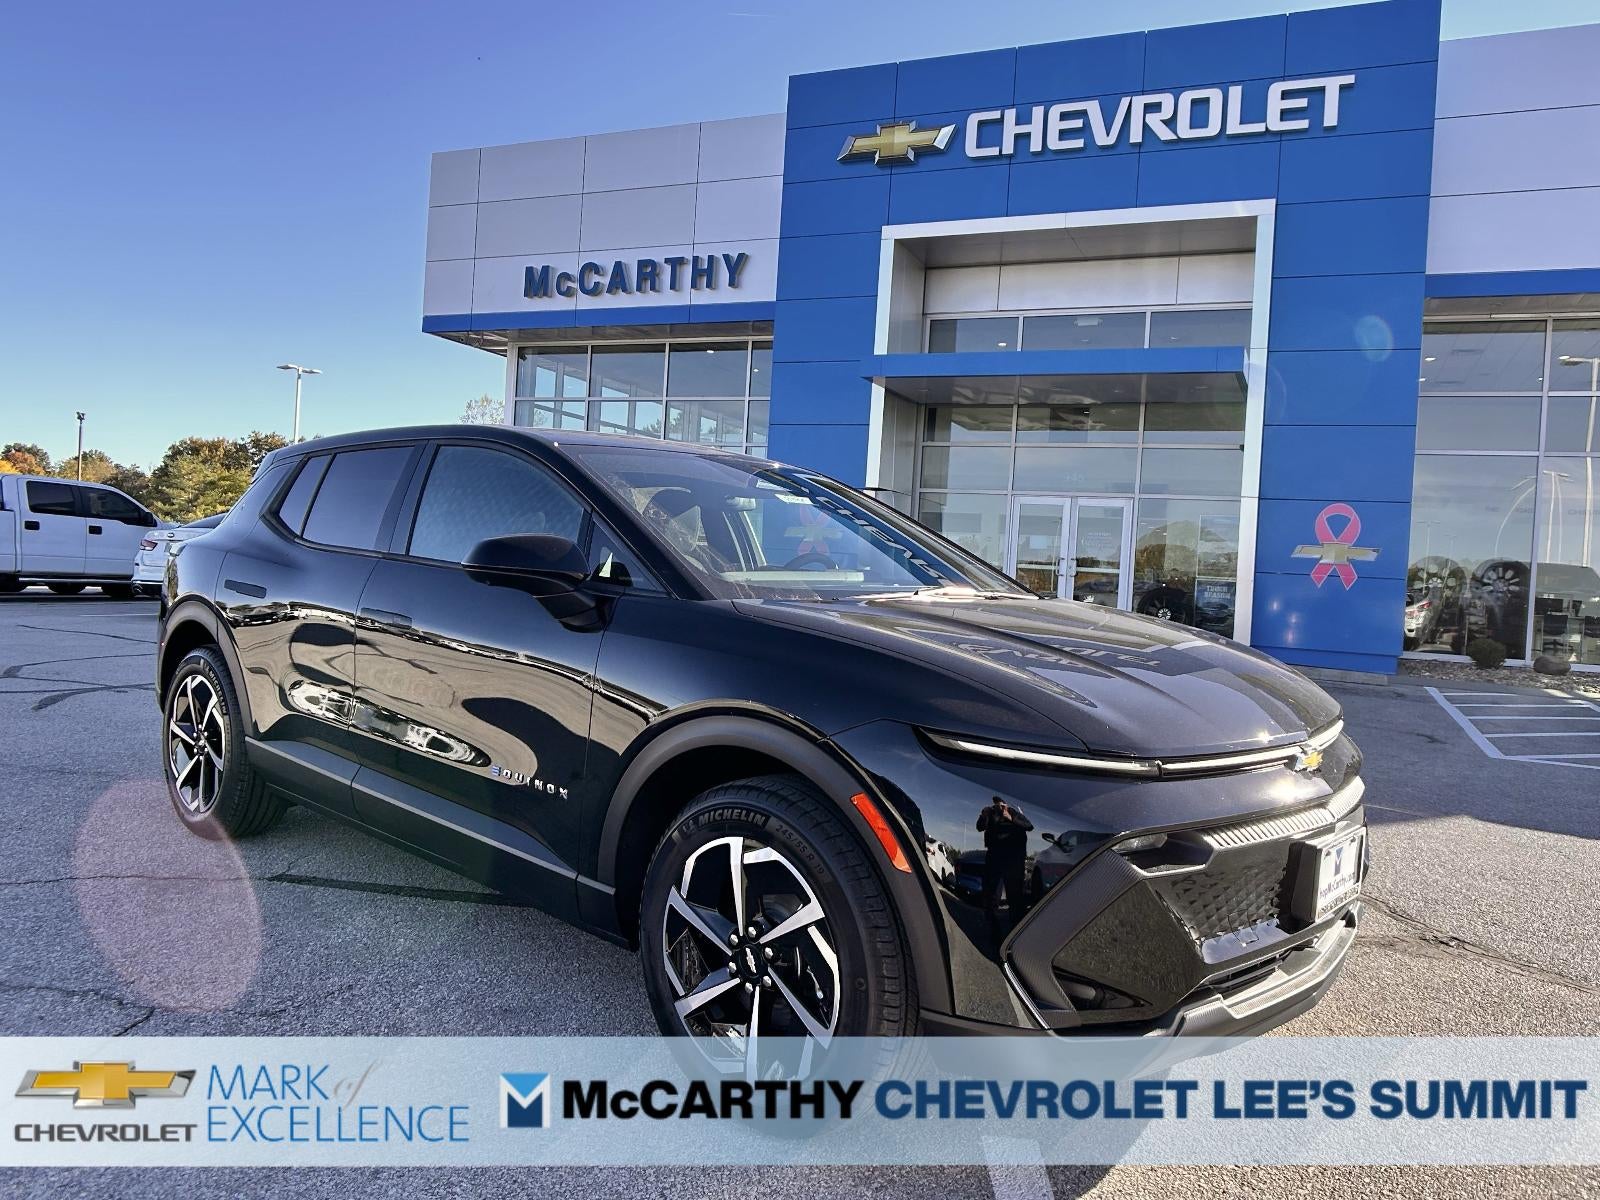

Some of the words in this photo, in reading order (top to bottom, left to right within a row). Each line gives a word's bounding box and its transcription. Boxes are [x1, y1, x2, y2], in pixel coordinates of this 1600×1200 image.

[965, 74, 1356, 159] CHEVROLET
[523, 252, 749, 299] McCARTHY
[491, 765, 569, 800] EQUINOX
[698, 808, 766, 827] MICHELIN
